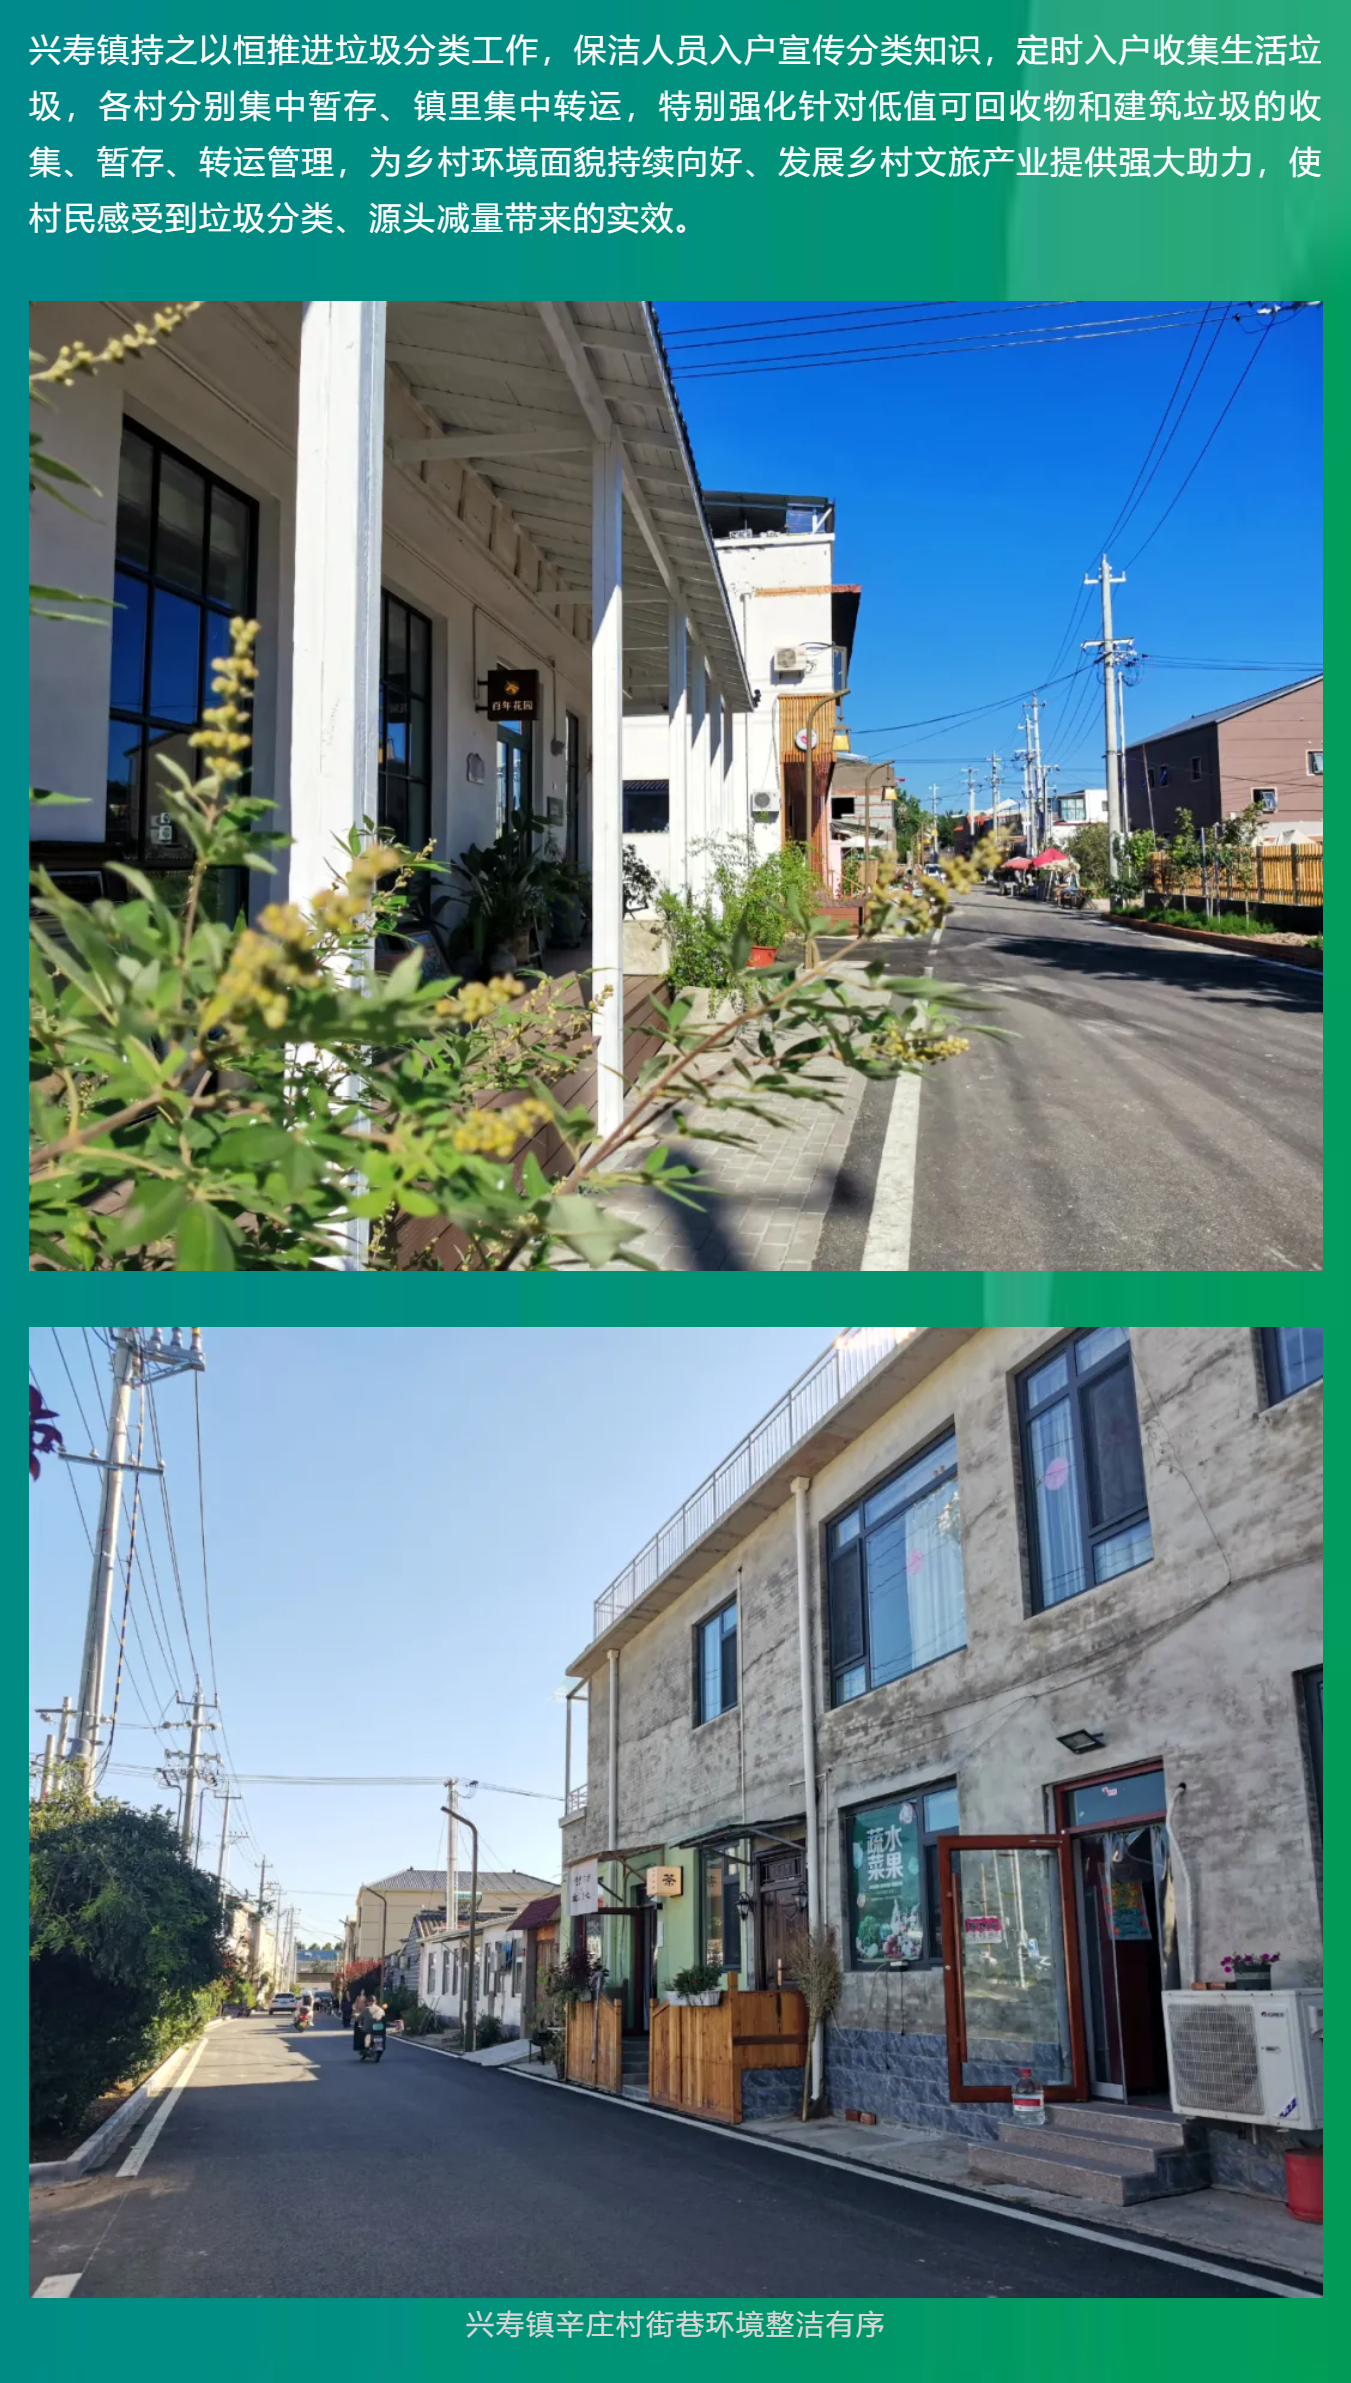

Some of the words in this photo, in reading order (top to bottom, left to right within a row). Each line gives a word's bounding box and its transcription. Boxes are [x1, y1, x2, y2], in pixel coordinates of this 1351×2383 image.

[492, 700, 533, 711] 百年花园
[662, 1873, 677, 1886] 茶
